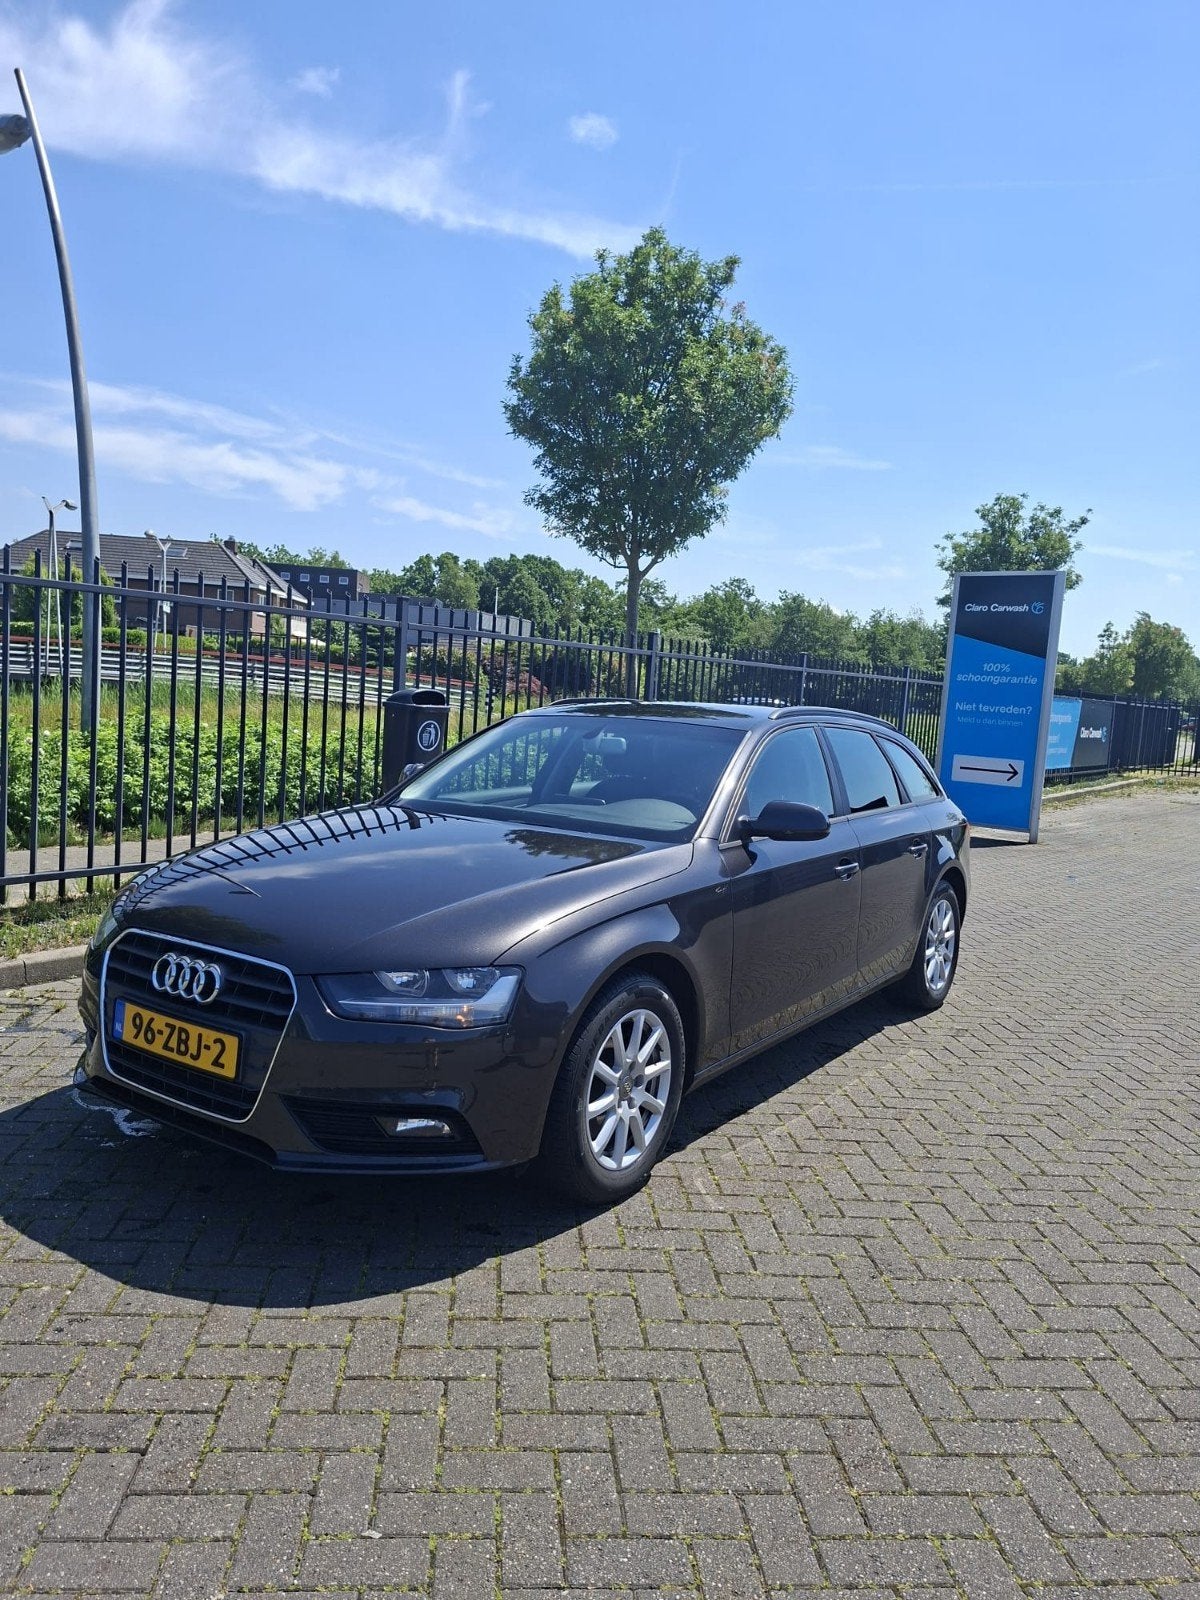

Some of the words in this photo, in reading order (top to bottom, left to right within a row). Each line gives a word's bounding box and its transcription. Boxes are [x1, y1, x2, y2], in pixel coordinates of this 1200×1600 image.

[965, 603, 988, 612] Claro
[990, 603, 1029, 612] Carwash
[983, 662, 1011, 672] 100%
[956, 673, 1038, 685] schoongarantie
[955, 702, 976, 711] Niet
[979, 703, 1032, 715] tevreden?
[132, 1012, 226, 1069] 96-ZBJ-2
